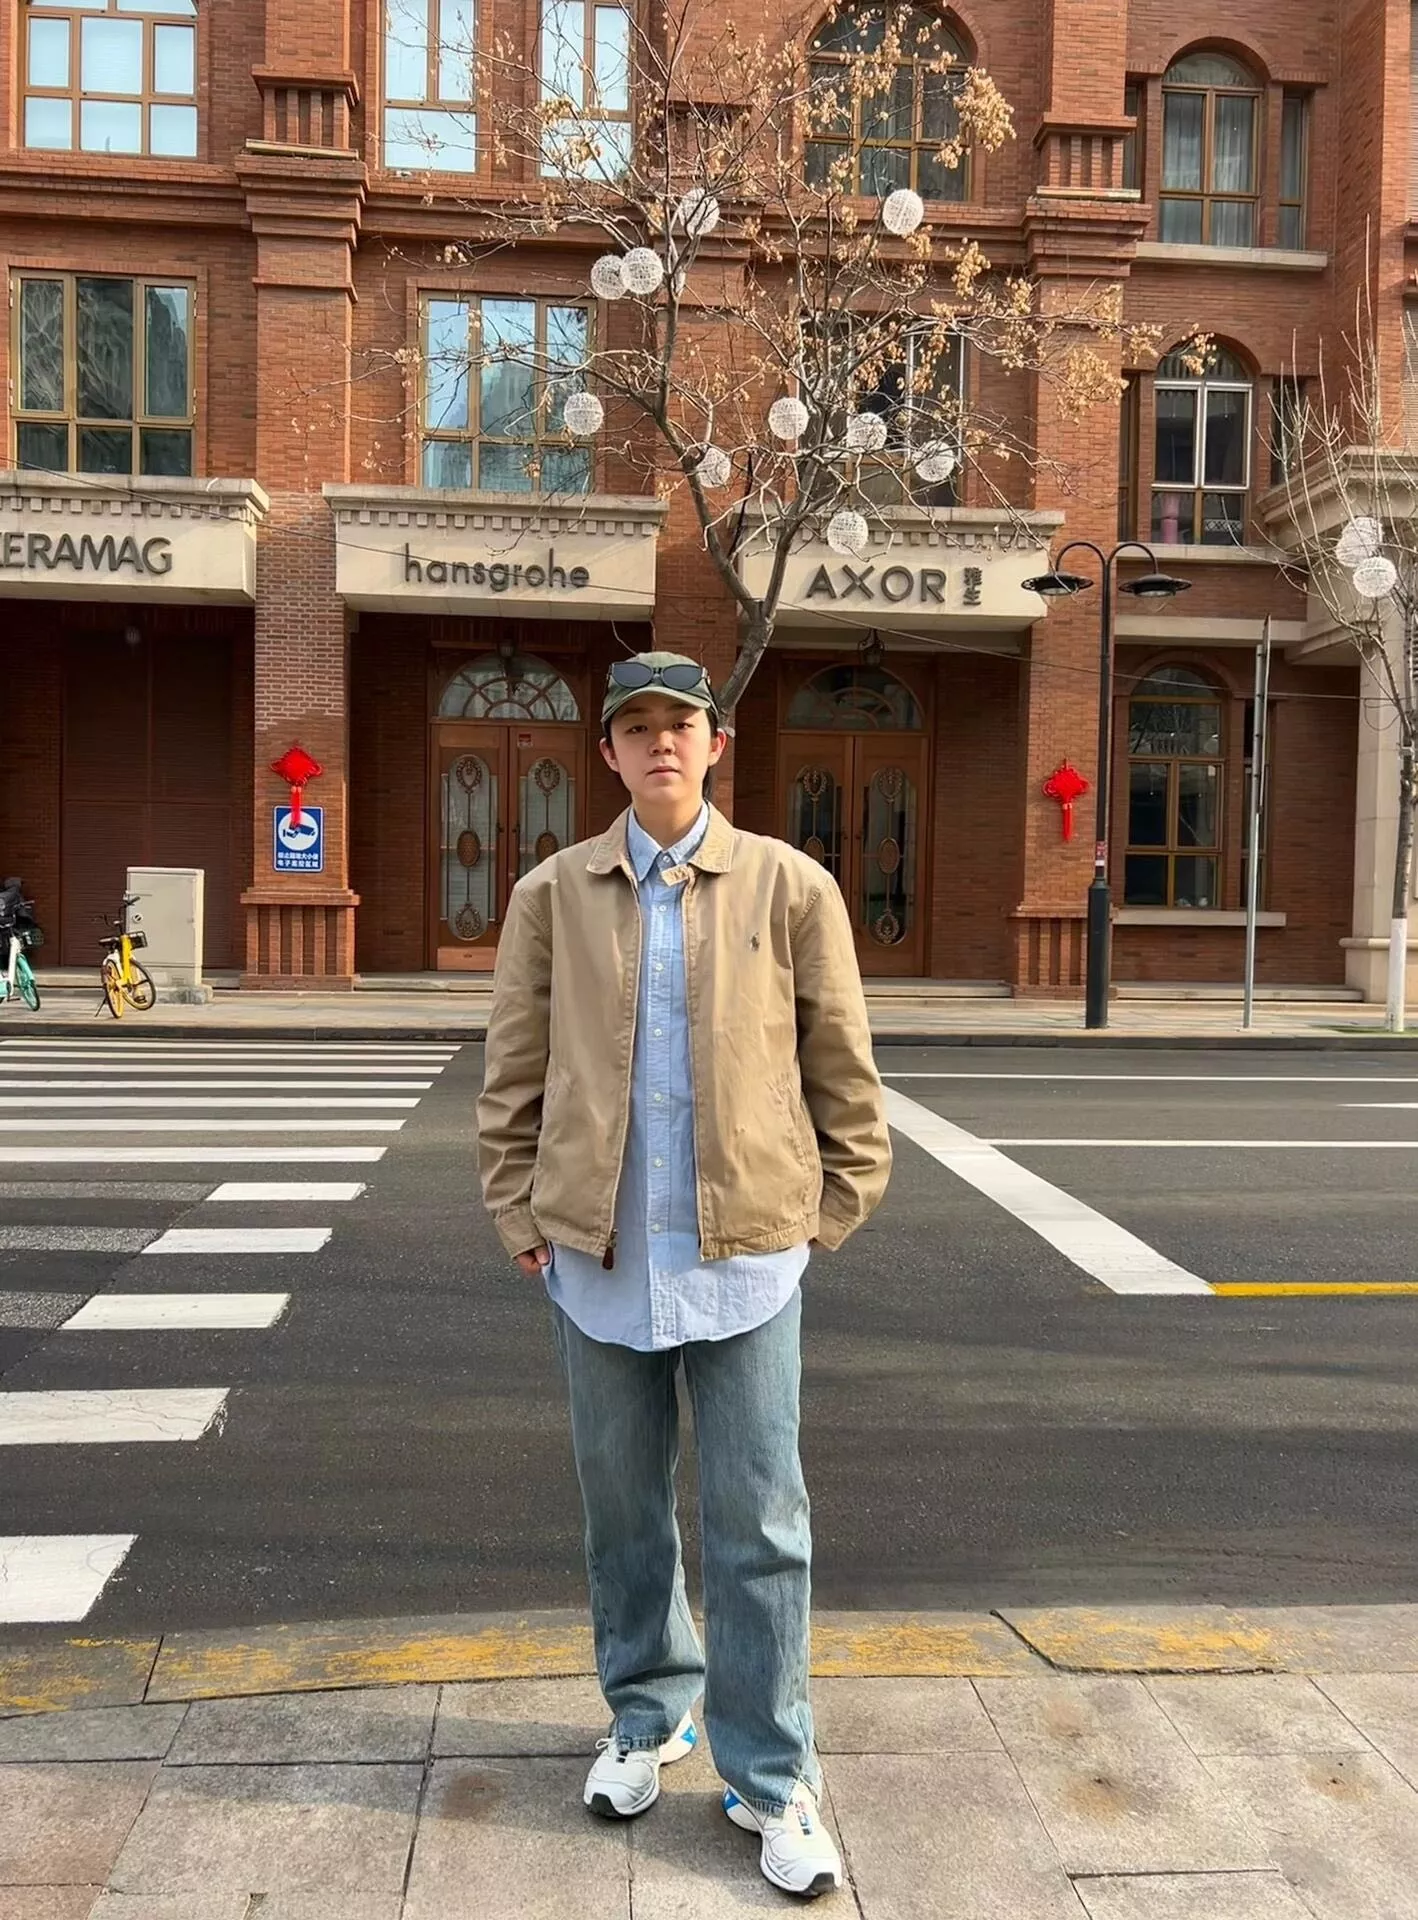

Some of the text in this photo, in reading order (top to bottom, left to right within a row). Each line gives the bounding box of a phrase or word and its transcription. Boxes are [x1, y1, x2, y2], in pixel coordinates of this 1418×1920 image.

[0, 531, 173, 574] ERAMAG
[404, 542, 590, 592] hansgrohe
[806, 563, 947, 603] AXOR
